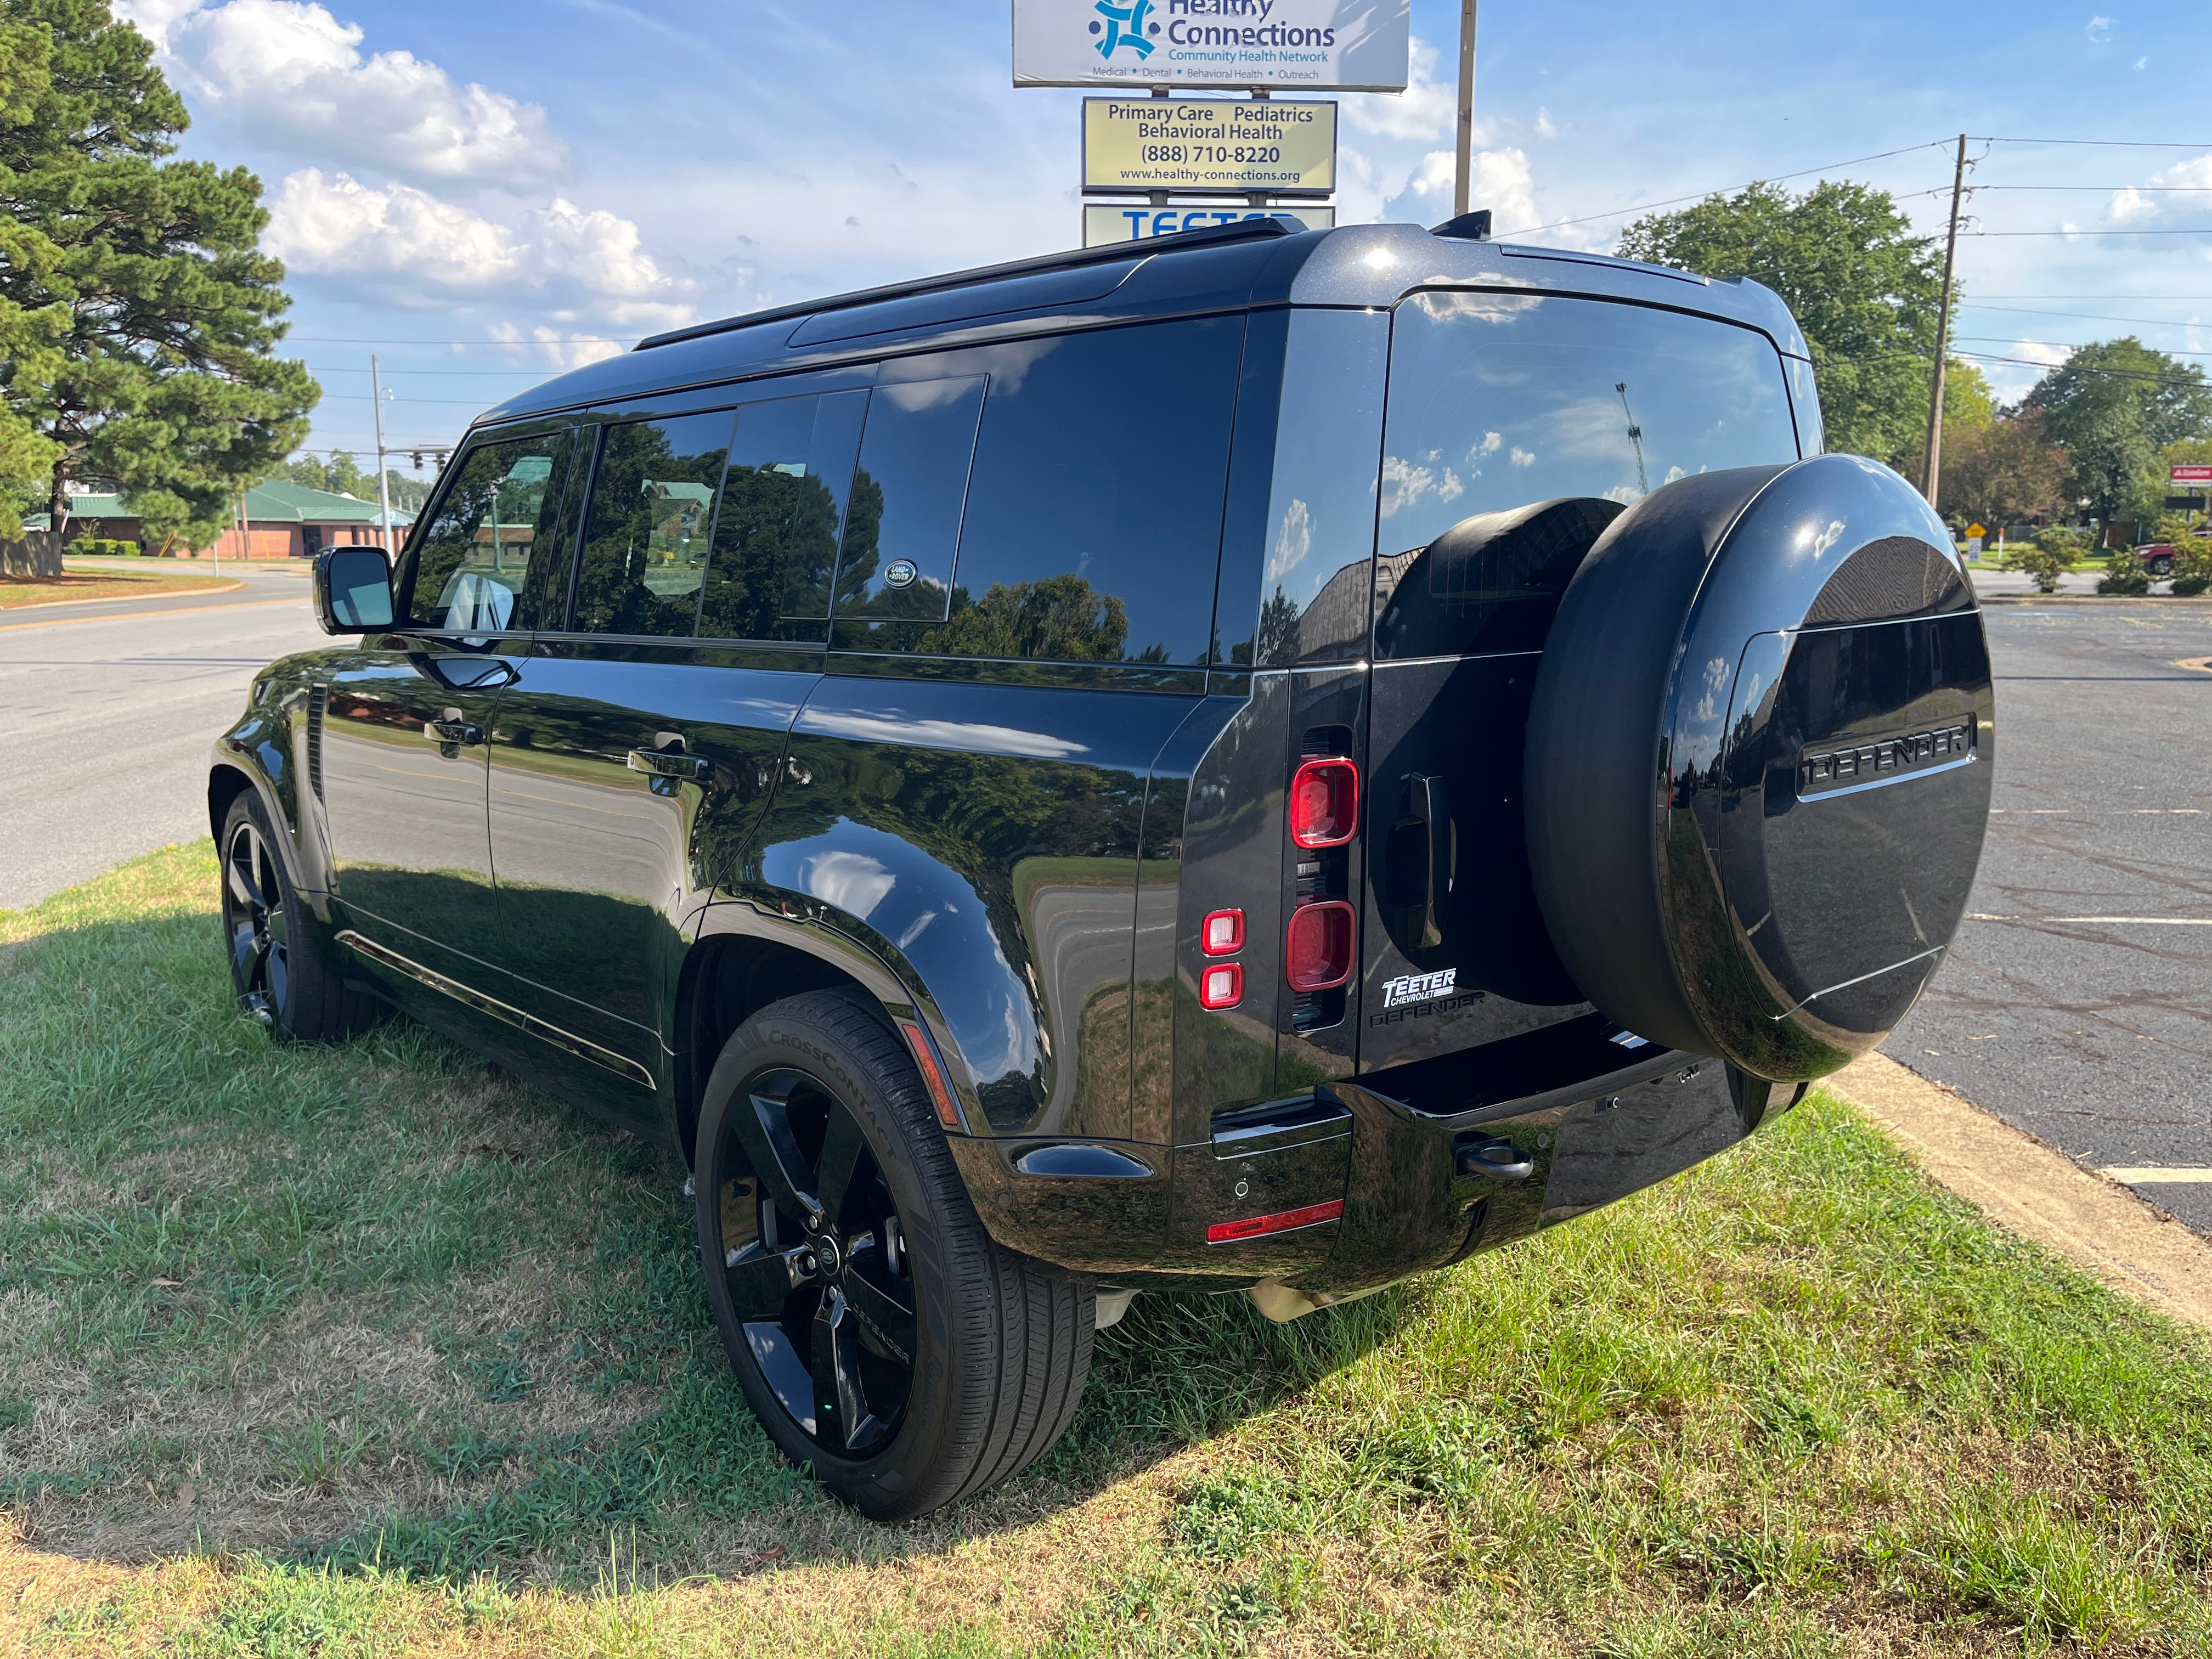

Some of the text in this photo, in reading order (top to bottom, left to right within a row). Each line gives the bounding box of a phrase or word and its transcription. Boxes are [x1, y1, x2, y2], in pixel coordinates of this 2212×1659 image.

[1169, 20, 1335, 47] Connections
[1169, 49, 1329, 63] Community Health Network
[1092, 67, 1319, 79] Medical Dental Behavioral Health Outreach
[1109, 105, 1313, 123] Primary Care Pediatrics
[1139, 123, 1283, 139] Behavioral Health
[1142, 145, 1280, 164] (888) 710-8220
[1121, 168, 1300, 183] www.healthy-connections.org
[1808, 725, 1965, 785] DEFENDER
[1382, 968, 1456, 1008] TEETER
[1390, 990, 1436, 1006] CHEVROLET
[1369, 991, 1486, 1029] DEFENDER
[851, 1302, 911, 1365] DEFENDER
